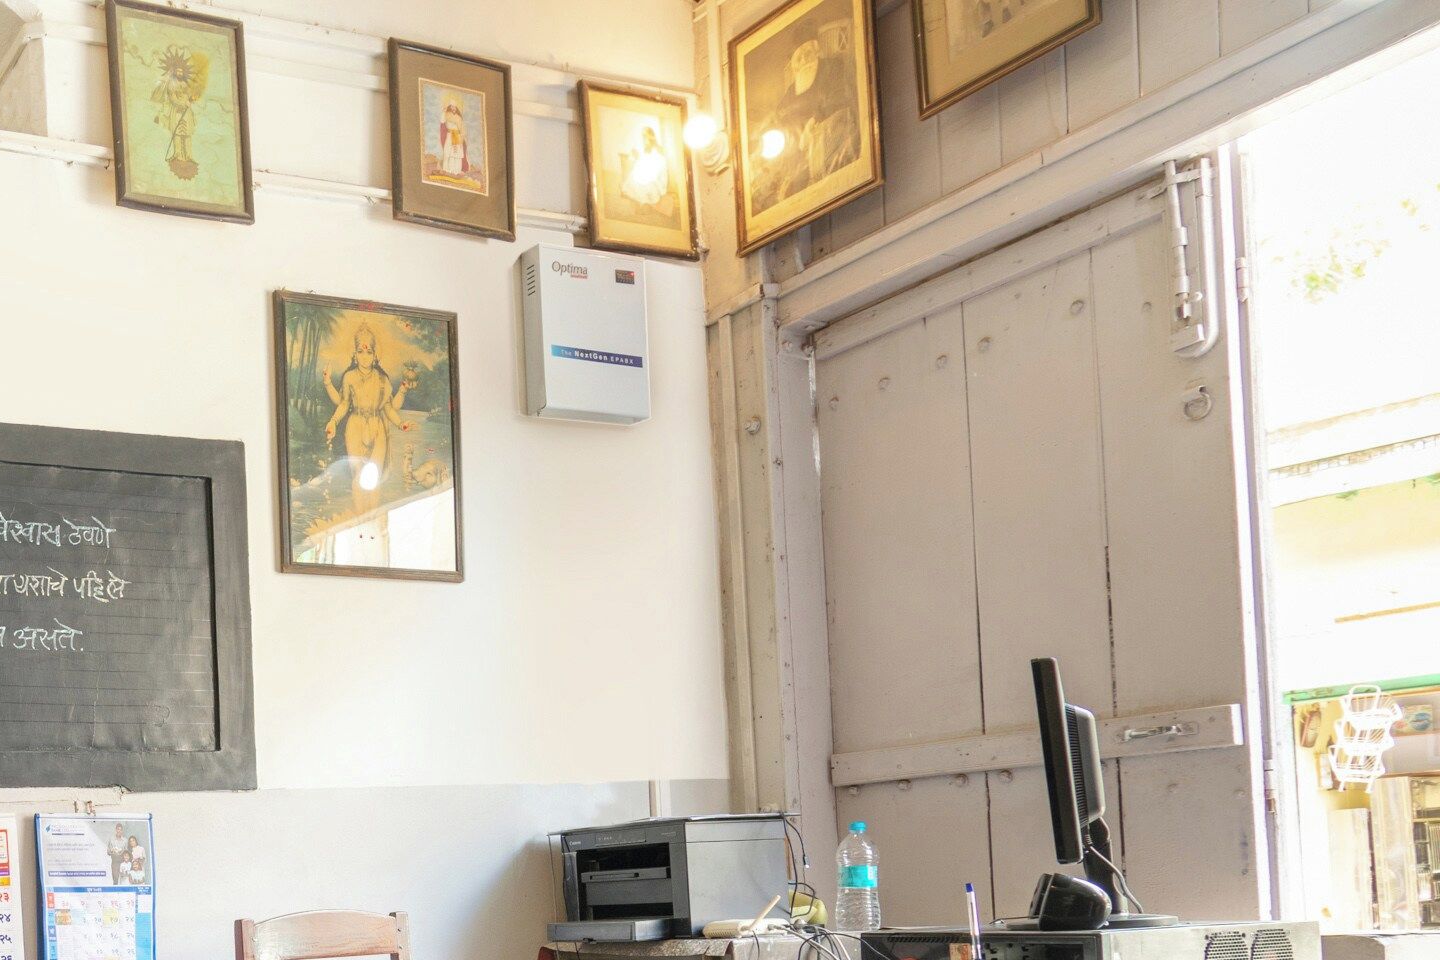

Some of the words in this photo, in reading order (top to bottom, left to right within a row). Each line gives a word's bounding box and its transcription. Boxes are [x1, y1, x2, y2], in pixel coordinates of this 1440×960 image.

[552, 261, 588, 276] Optima
[574, 350, 608, 361] NextGen
[610, 355, 634, 365] EPABX
[0, 934, 12, 944] २५
